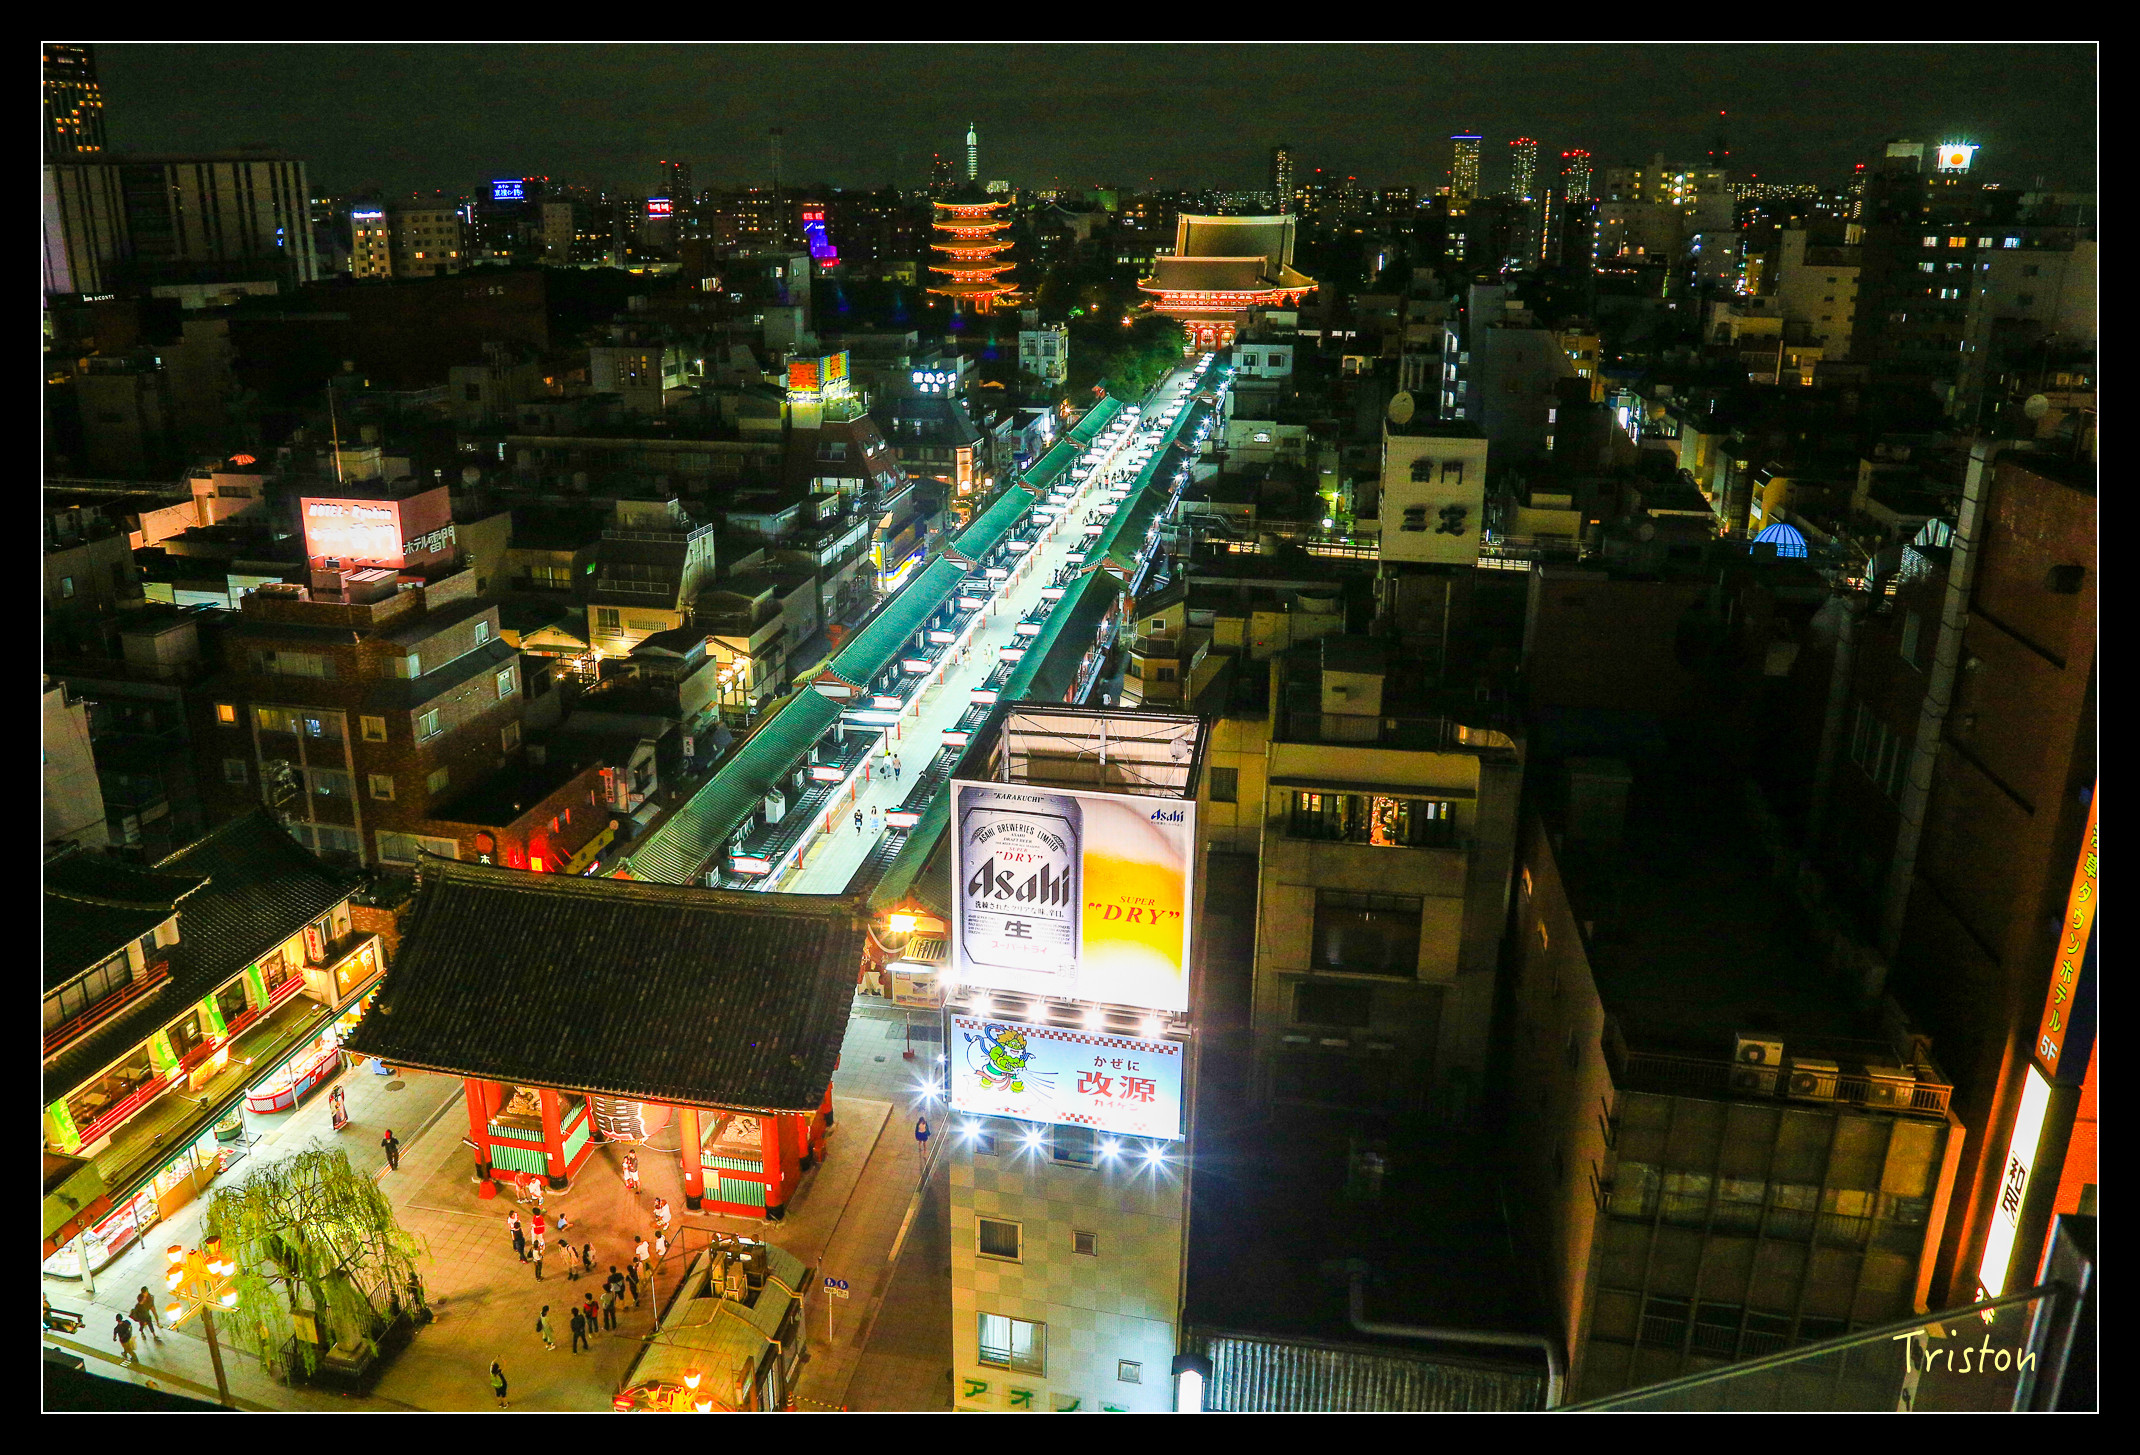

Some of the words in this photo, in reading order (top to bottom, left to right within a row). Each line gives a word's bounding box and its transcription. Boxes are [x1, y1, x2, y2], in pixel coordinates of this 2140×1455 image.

[1409, 459, 1464, 485] 雷門
[308, 502, 344, 518] HOTEL
[352, 504, 392, 521] Ryokan
[1400, 507, 1467, 537] 三定
[1150, 808, 1184, 823] Asahi
[978, 827, 996, 844] ASAHI
[996, 823, 1035, 836] BREWERIES
[1037, 830, 1060, 852] LIMITED
[968, 856, 1070, 907] Asahi
[1119, 895, 1156, 906] SUPER
[1004, 920, 1033, 940] 生
[2040, 1034, 2059, 1062] 5F
[1093, 1055, 1140, 1072] かぜに
[1076, 1070, 1157, 1103] 改源
